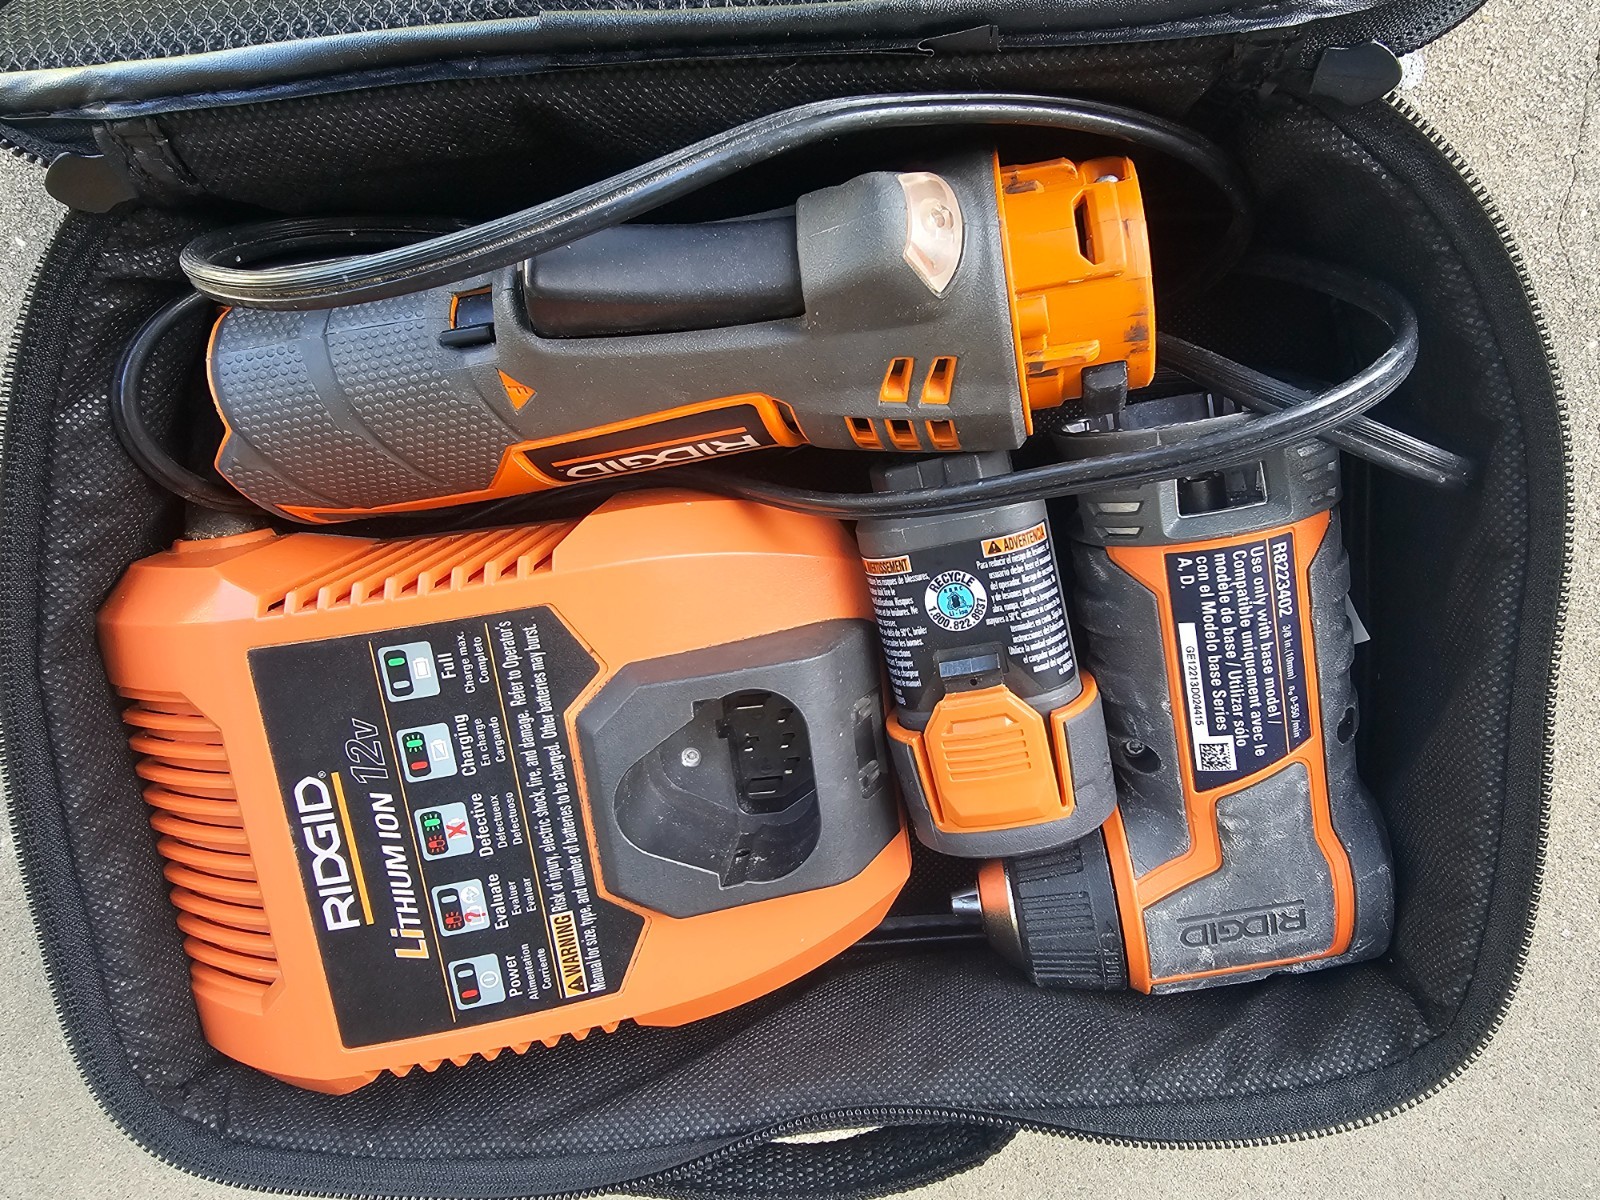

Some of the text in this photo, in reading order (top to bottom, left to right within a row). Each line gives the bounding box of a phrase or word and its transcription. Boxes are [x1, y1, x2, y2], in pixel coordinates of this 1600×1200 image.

[566, 434, 761, 478] RIDGID
[976, 560, 988, 570] Para
[989, 567, 1009, 579] usuario
[1177, 558, 1194, 589] A, D.
[1214, 553, 1233, 604] modèle
[1250, 546, 1264, 573] Use
[1273, 542, 1292, 618] R8223402
[929, 572, 975, 593] RECYCLE
[1253, 577, 1269, 605] only
[929, 597, 986, 630] 1.800.822.8837
[1220, 607, 1235, 623] de
[1257, 608, 1272, 640] with
[1282, 624, 1292, 638] 3/8
[457, 631, 475, 694] Charge max.
[474, 636, 490, 683] Completo
[1196, 556, 1230, 730] con el Modelo base Series
[1223, 627, 1237, 659] base
[1232, 550, 1268, 756] Compatible uniquement avec le
[1260, 642, 1274, 674] base
[438, 652, 456, 679] Full
[1185, 645, 1205, 726] GE12213D024415
[1228, 670, 1245, 716] Utilizar
[1264, 677, 1280, 718] model
[454, 714, 477, 777] Charging
[475, 718, 491, 767] En charge
[489, 717, 506, 763] Cargando
[1233, 720, 1250, 747] sólo
[370, 792, 401, 838] ION
[495, 620, 581, 977] WARNING Risk of injury, electric shock, fire, and damage. Refer to Operator's
[505, 791, 523, 845] Defectuoso
[522, 624, 606, 992] Manual for size, type, and number of batteries to be charged. Other batteries may burst.
[471, 793, 495, 858] Defective
[490, 794, 508, 848] Défectueux
[294, 775, 361, 931] RIDGID
[488, 874, 509, 930] Evaluate
[508, 881, 522, 916] Evaluer
[524, 877, 537, 912] Evaluar
[1179, 909, 1307, 948] RIDGID
[505, 955, 523, 997] Power
[520, 943, 539, 1000] Alimentation
[537, 948, 552, 989] Corriente
